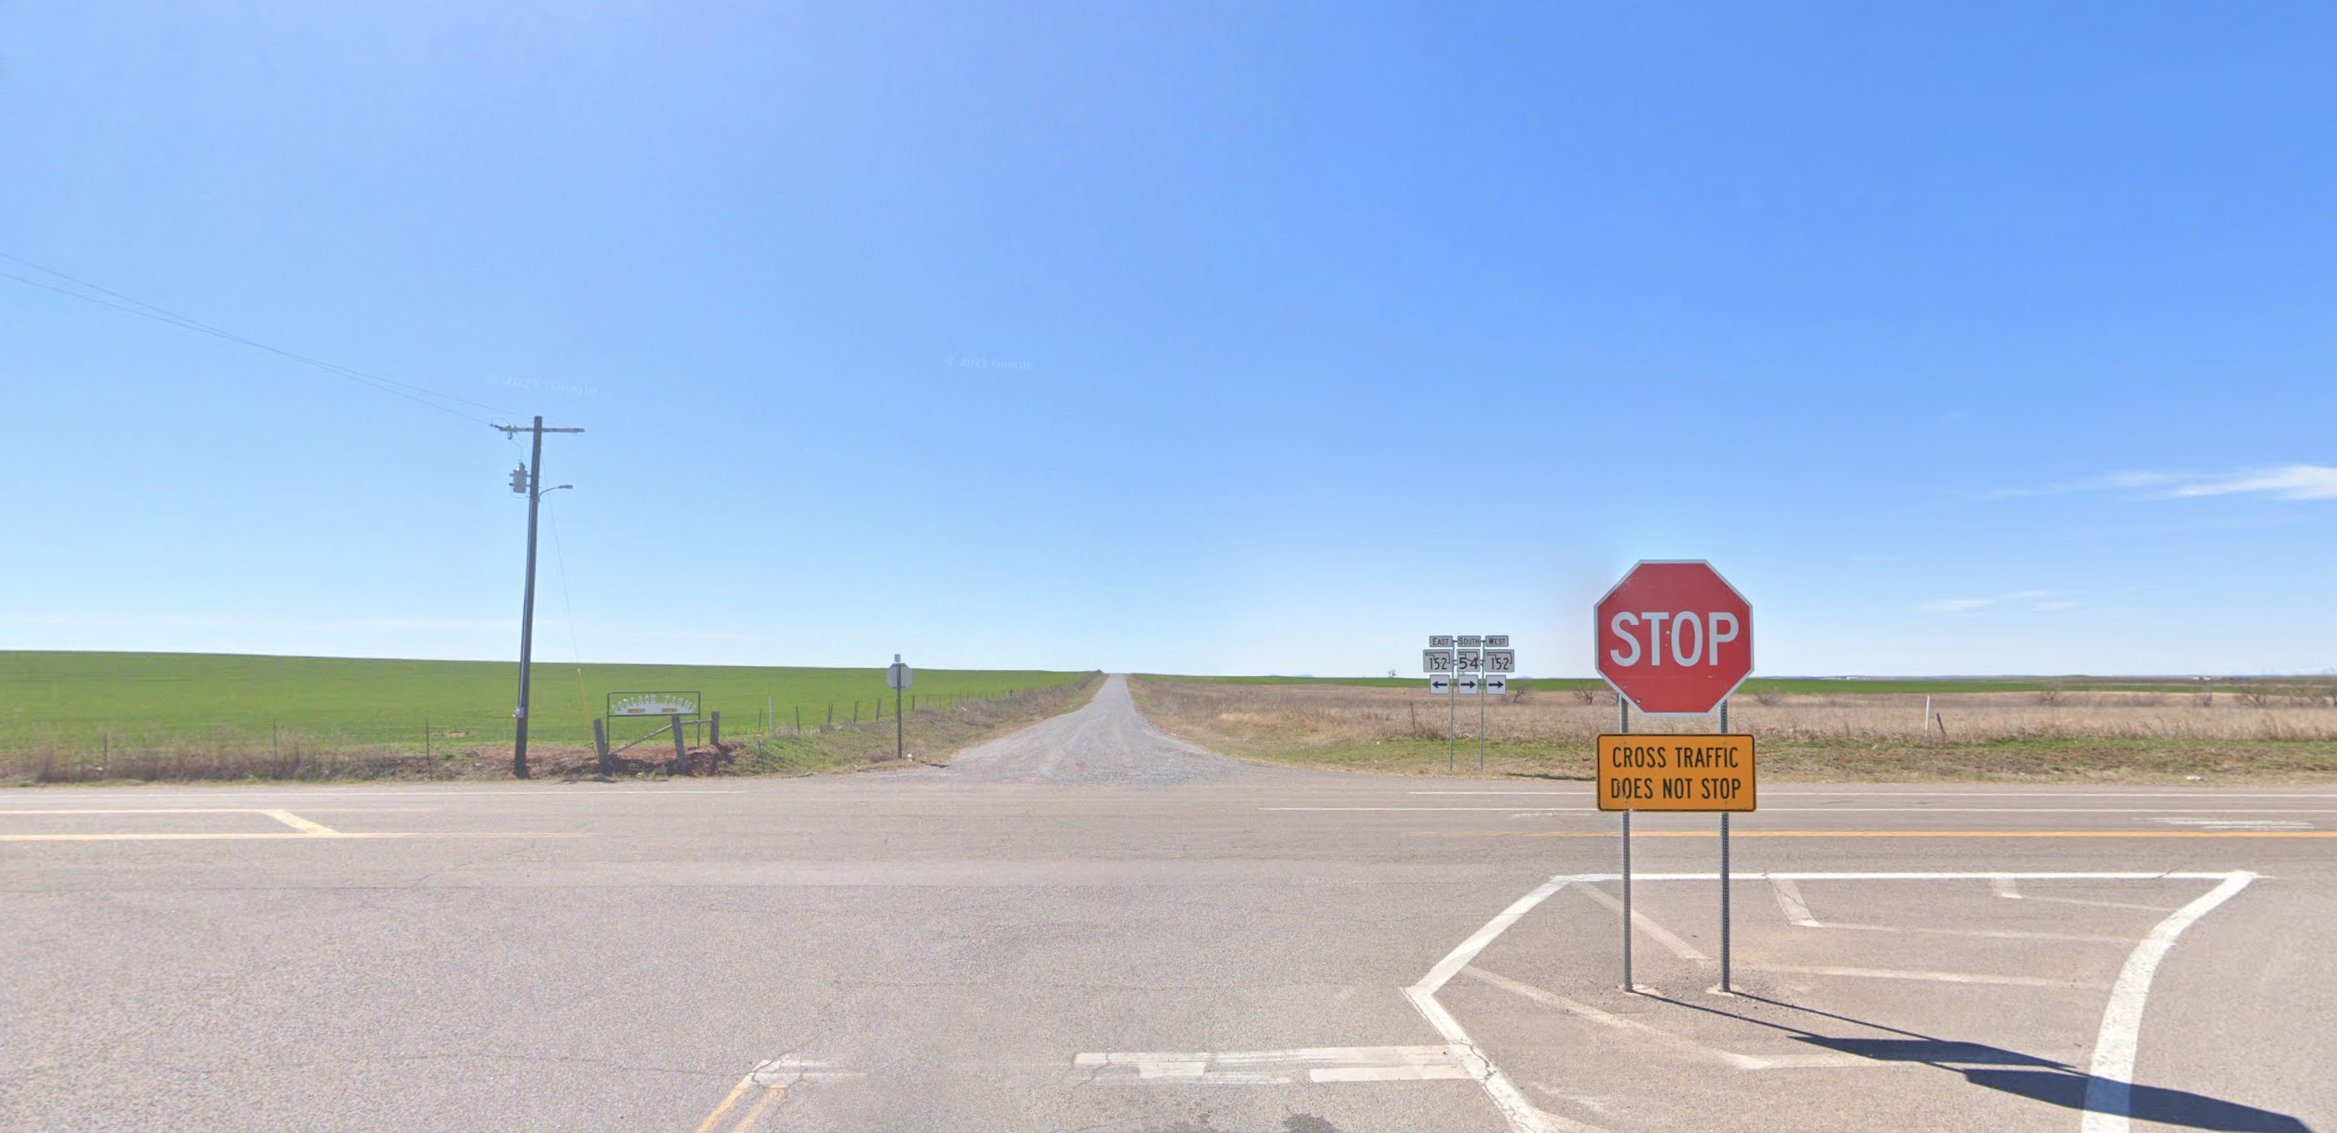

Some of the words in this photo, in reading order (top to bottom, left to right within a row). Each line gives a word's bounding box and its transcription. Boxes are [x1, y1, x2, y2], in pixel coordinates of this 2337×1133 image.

[1459, 637, 1480, 645] SOUTH
[1610, 611, 1739, 667] STOP
[1429, 657, 1447, 670] 152
[1459, 657, 1478, 670] 54
[1491, 657, 1509, 670] 152
[1613, 747, 1666, 768] CROSS
[1675, 747, 1738, 768] TRAFFIC
[1611, 778, 1653, 798] DOES
[1663, 778, 1692, 798] NOT
[1701, 778, 1741, 798] STOP
